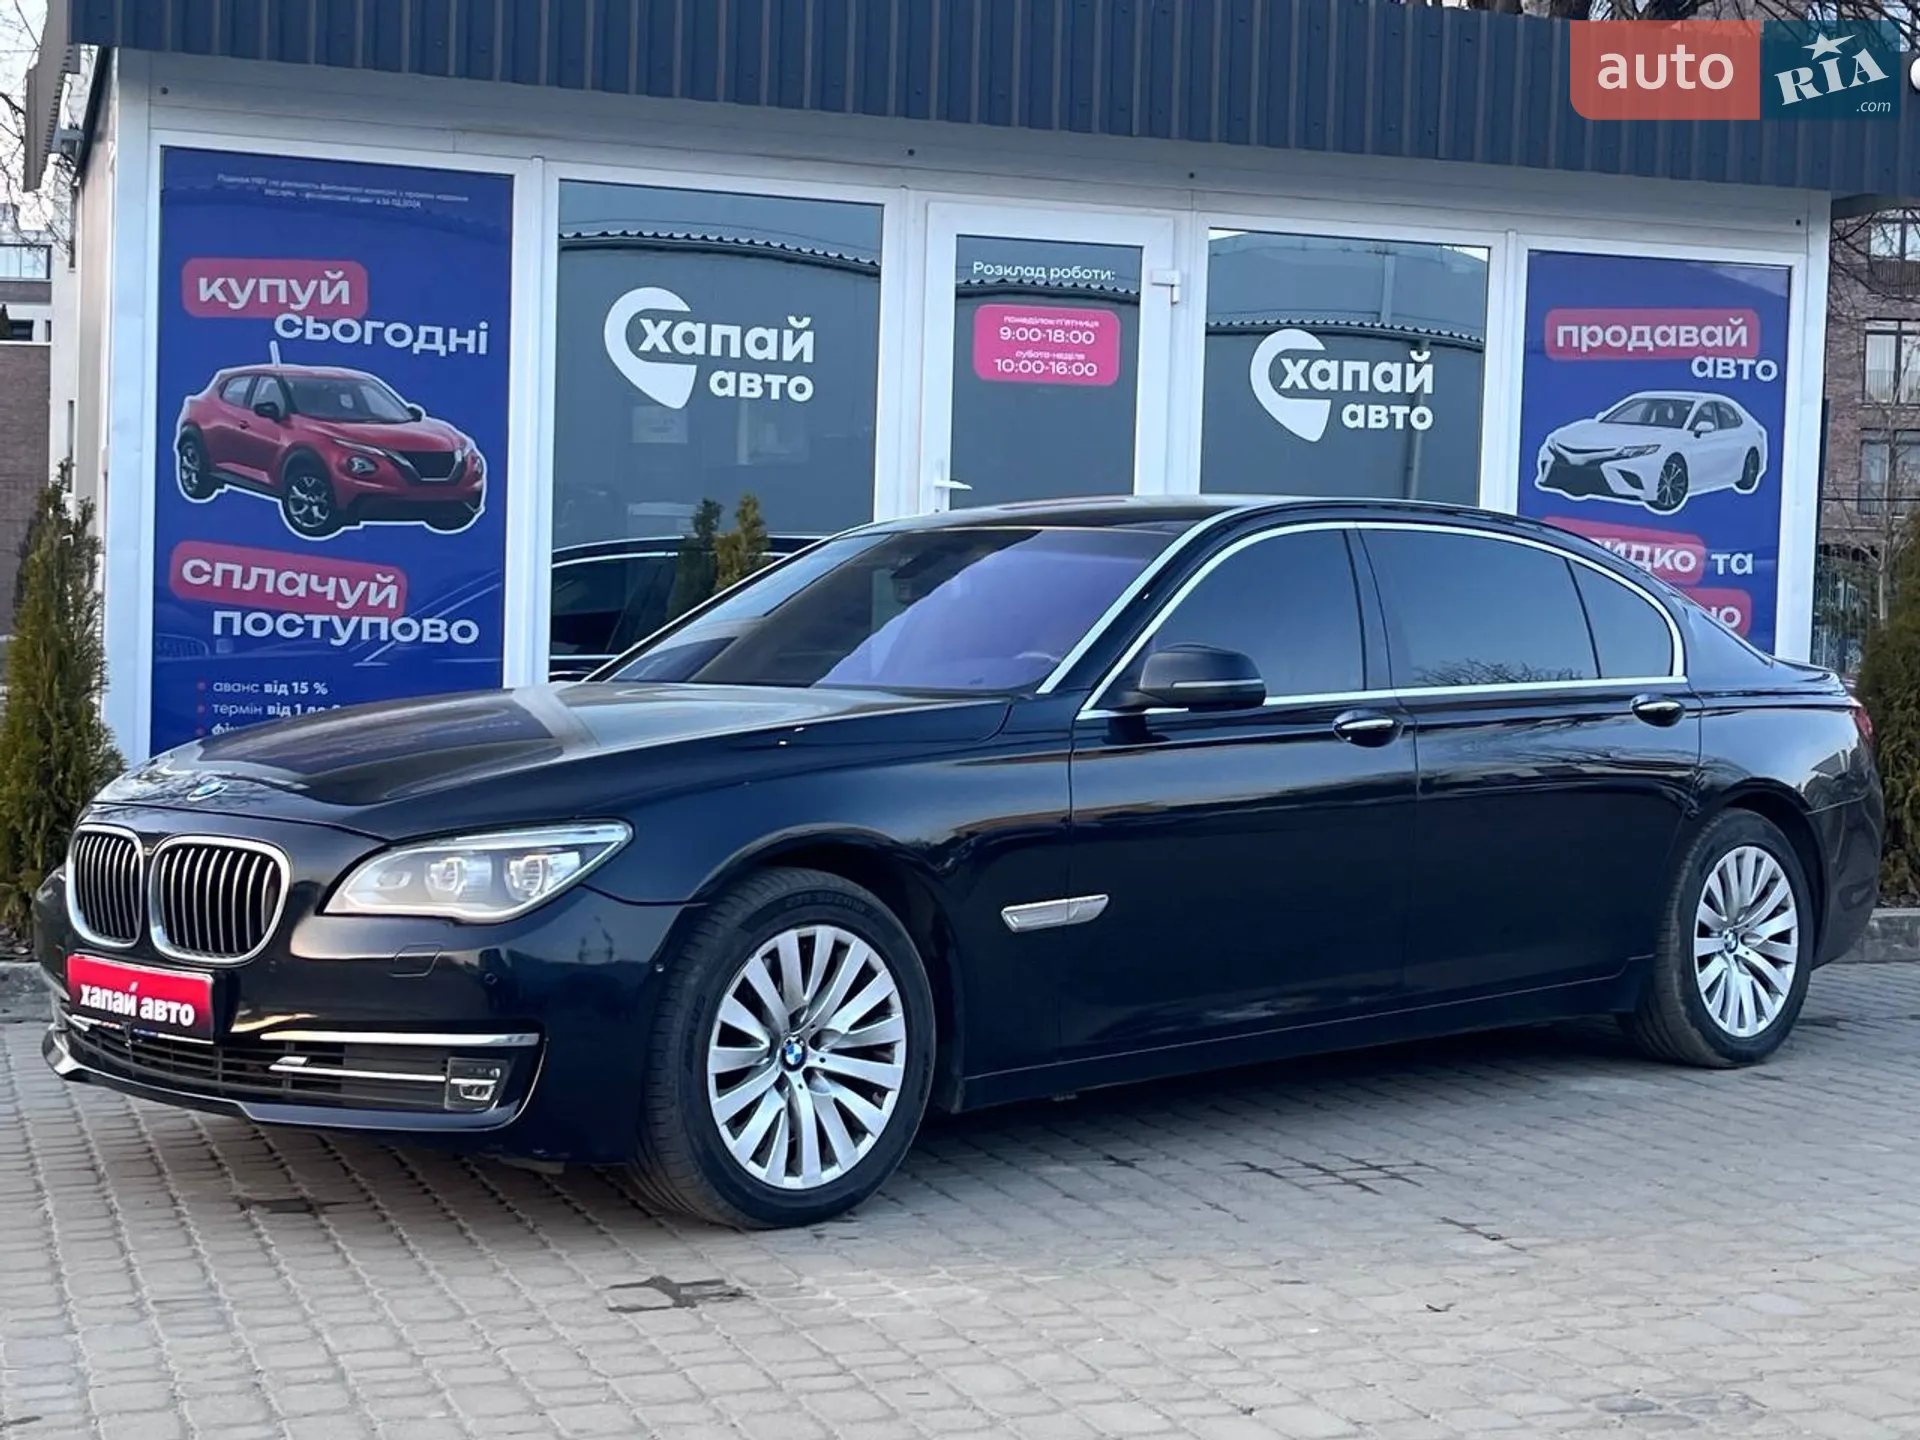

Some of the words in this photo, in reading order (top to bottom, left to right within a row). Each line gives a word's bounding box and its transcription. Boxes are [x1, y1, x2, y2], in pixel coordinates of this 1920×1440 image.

[972, 261, 1047, 280] Розклад
[1049, 264, 1116, 281] роботи:
[198, 270, 350, 311] купуй
[274, 313, 489, 357] сьогодні
[638, 315, 815, 364] хапай
[1556, 317, 1748, 353] продавай
[708, 369, 815, 403] авто
[1279, 350, 1434, 394] хапай
[1691, 355, 1778, 382] авто
[1341, 403, 1434, 431] авто
[1711, 552, 1754, 576] та
[181, 557, 400, 610] сплачуй
[212, 610, 480, 647] поступово
[212, 681, 260, 694] аванс
[263, 680, 289, 696] від
[291, 682, 309, 695] 15
[312, 682, 329, 696] %
[211, 703, 263, 717] термін
[266, 702, 291, 717] від
[79, 981, 140, 1018] хапай
[140, 996, 195, 1027] авто
